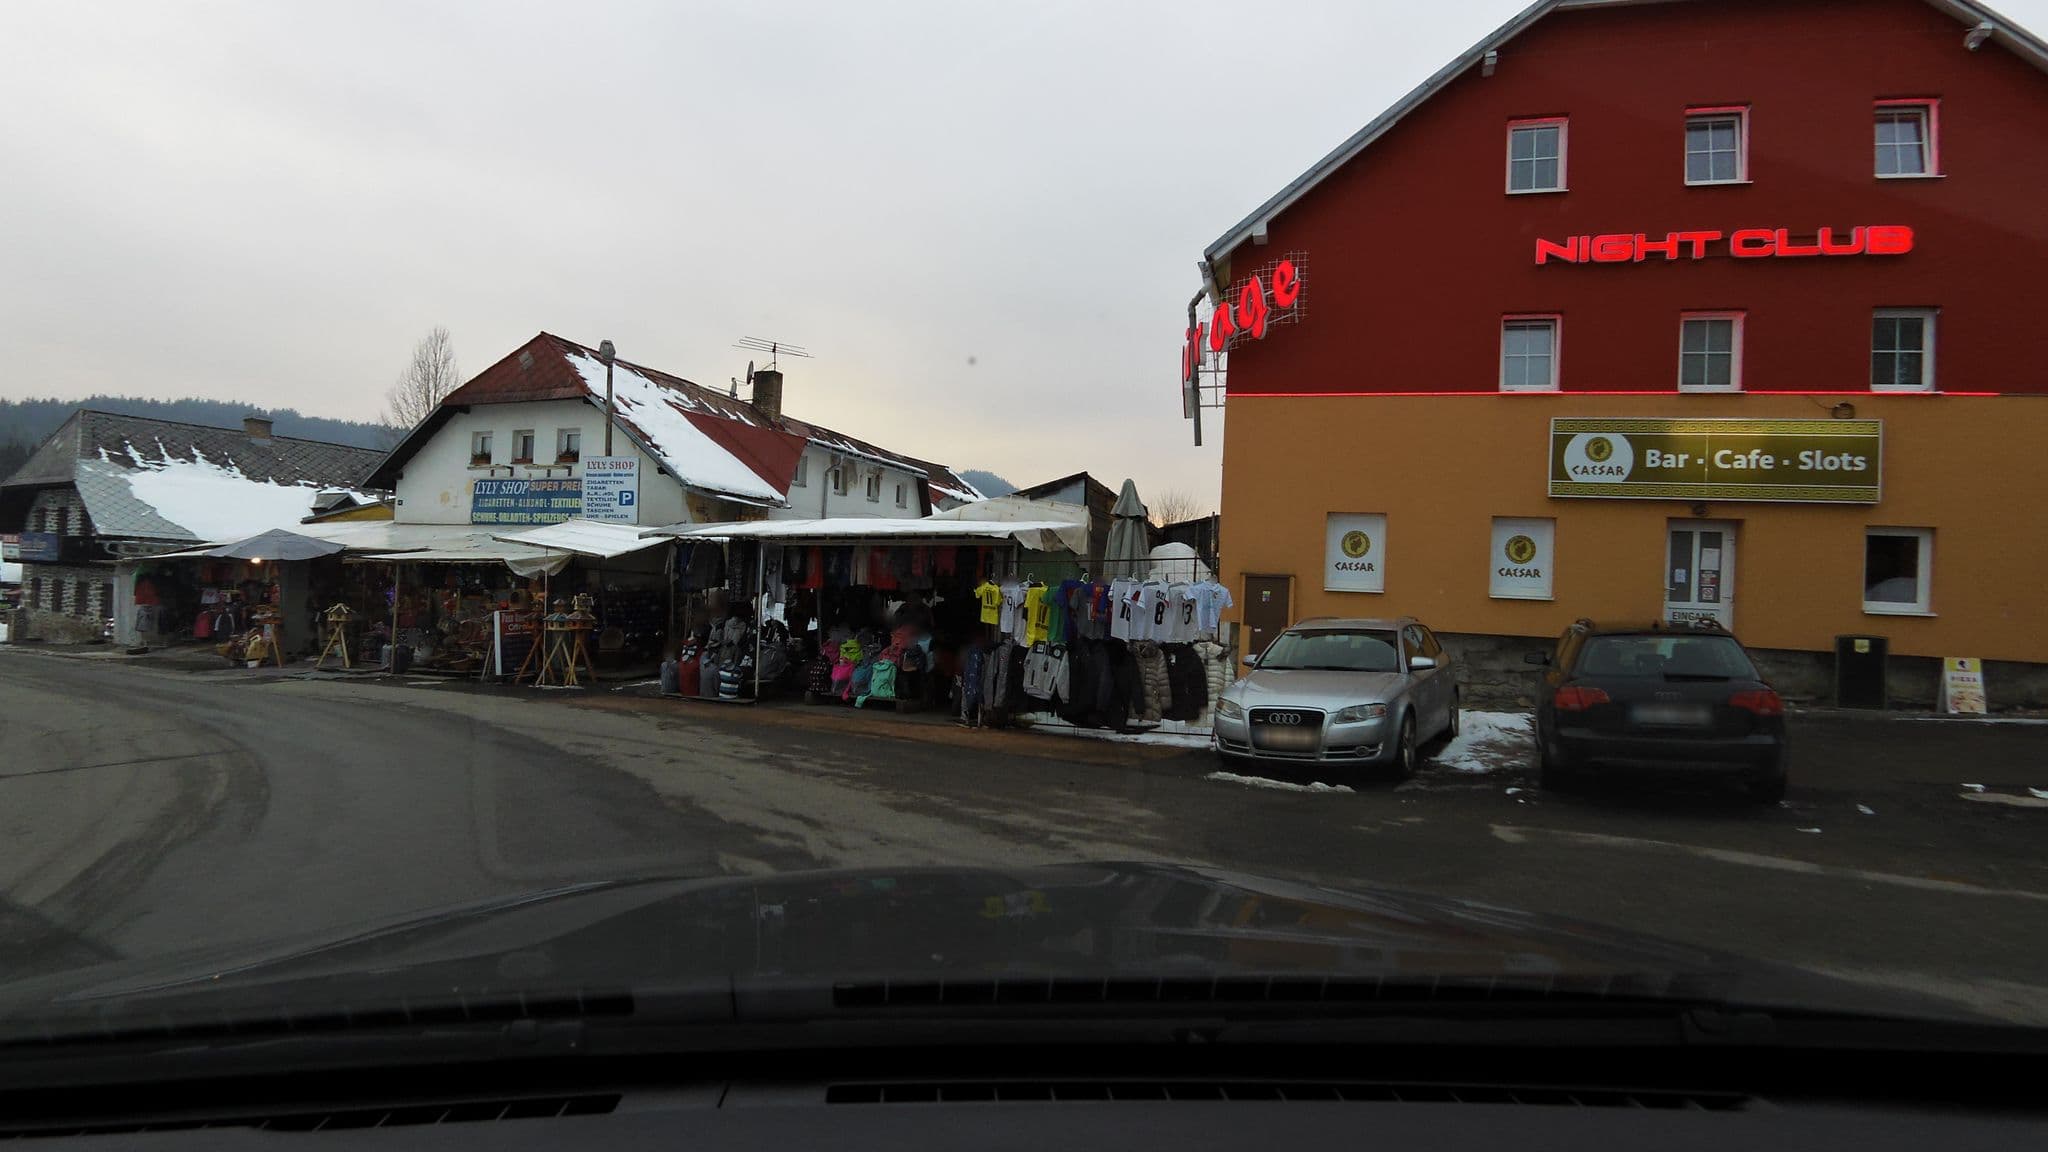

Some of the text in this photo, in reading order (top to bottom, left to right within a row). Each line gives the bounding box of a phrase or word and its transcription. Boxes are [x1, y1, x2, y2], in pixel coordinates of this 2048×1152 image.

[1534, 225, 1914, 265] NIGHT CLUB
[1183, 260, 1302, 418] irage
[586, 460, 635, 470] LYLY SHOP
[1645, 449, 1867, 472] Bar Cafe Slots
[1571, 465, 1626, 477] CAESAR
[475, 481, 529, 495] LYLY SHOP
[530, 481, 582, 491] SUPER PREI
[1334, 561, 1375, 572] CAESAR
[1498, 567, 1542, 578] CAESAR
[1154, 601, 1166, 625] 8
